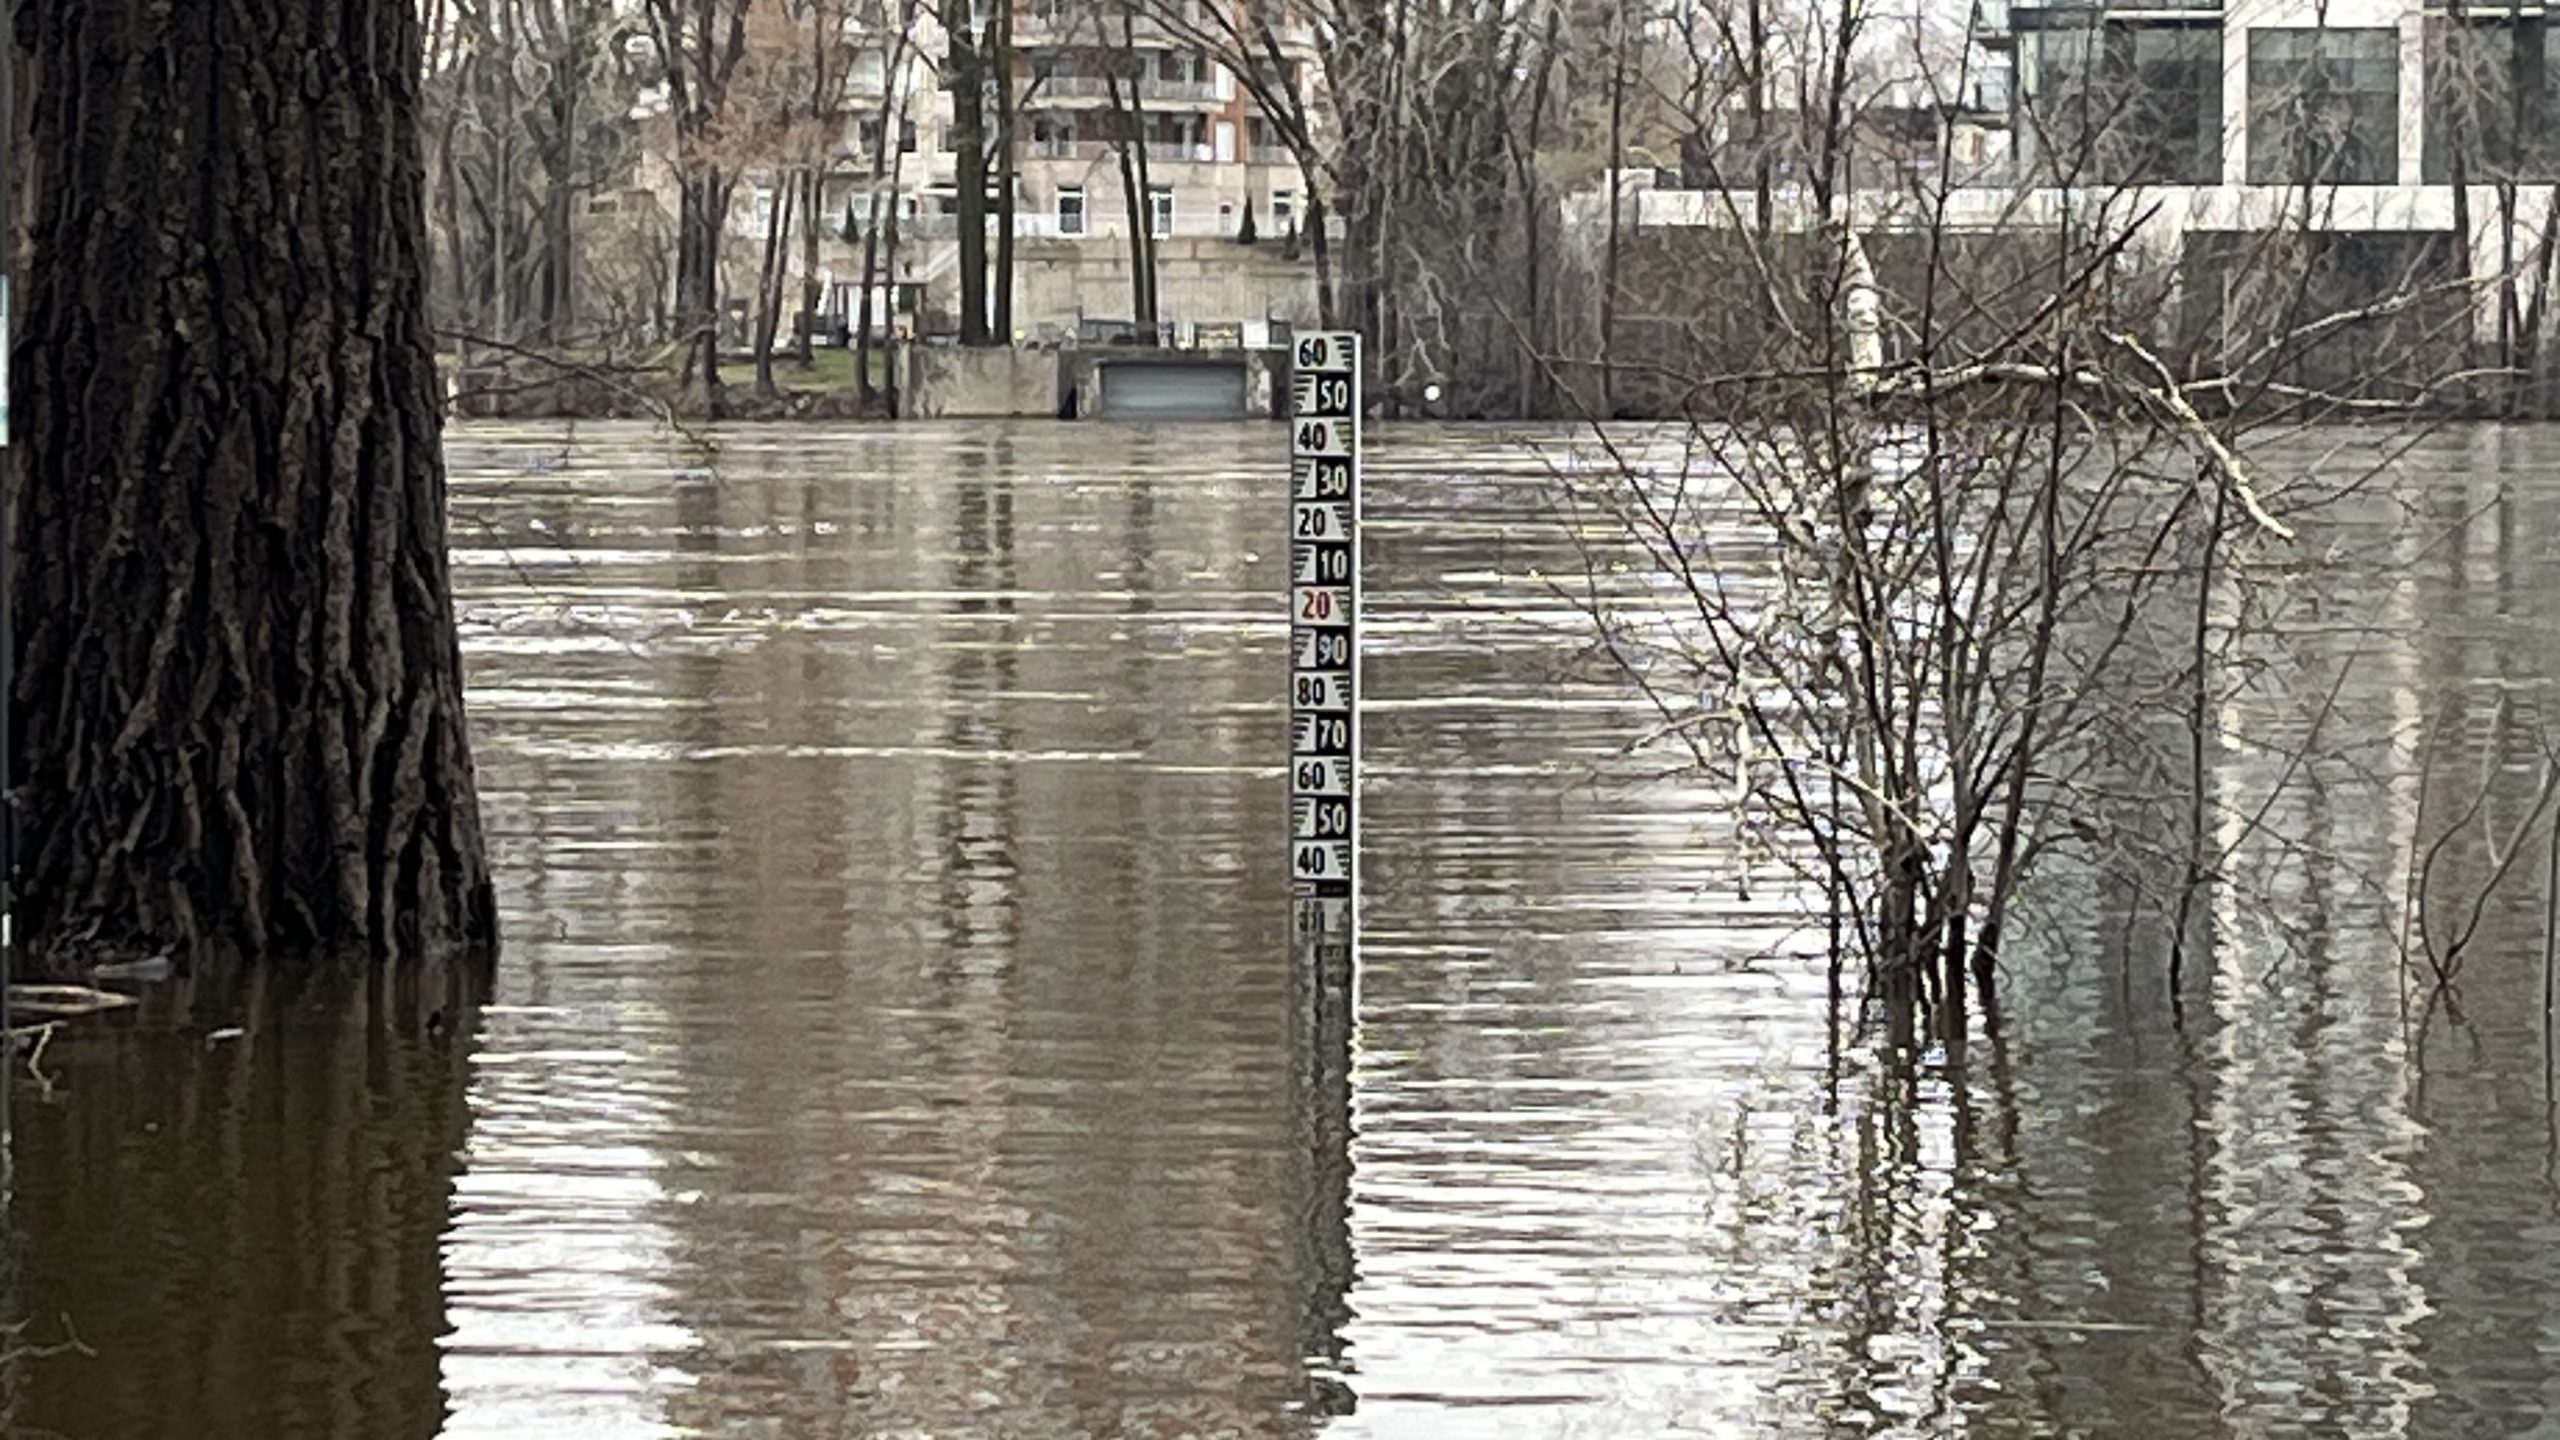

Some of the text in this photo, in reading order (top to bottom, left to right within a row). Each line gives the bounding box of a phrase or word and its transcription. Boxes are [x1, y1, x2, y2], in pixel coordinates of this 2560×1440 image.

[1299, 338, 1327, 366] 60
[1321, 380, 1348, 411] 50
[1298, 422, 1326, 451] 40
[1319, 464, 1348, 495] 30
[1298, 508, 1325, 536] 20
[1321, 550, 1347, 580] 10
[1302, 591, 1330, 620] 20
[1319, 634, 1347, 665] 90
[1297, 677, 1325, 706] 80
[1319, 719, 1346, 748] 70
[1298, 761, 1325, 789] 60
[1319, 803, 1346, 835] 50
[1297, 846, 1325, 874] 40
